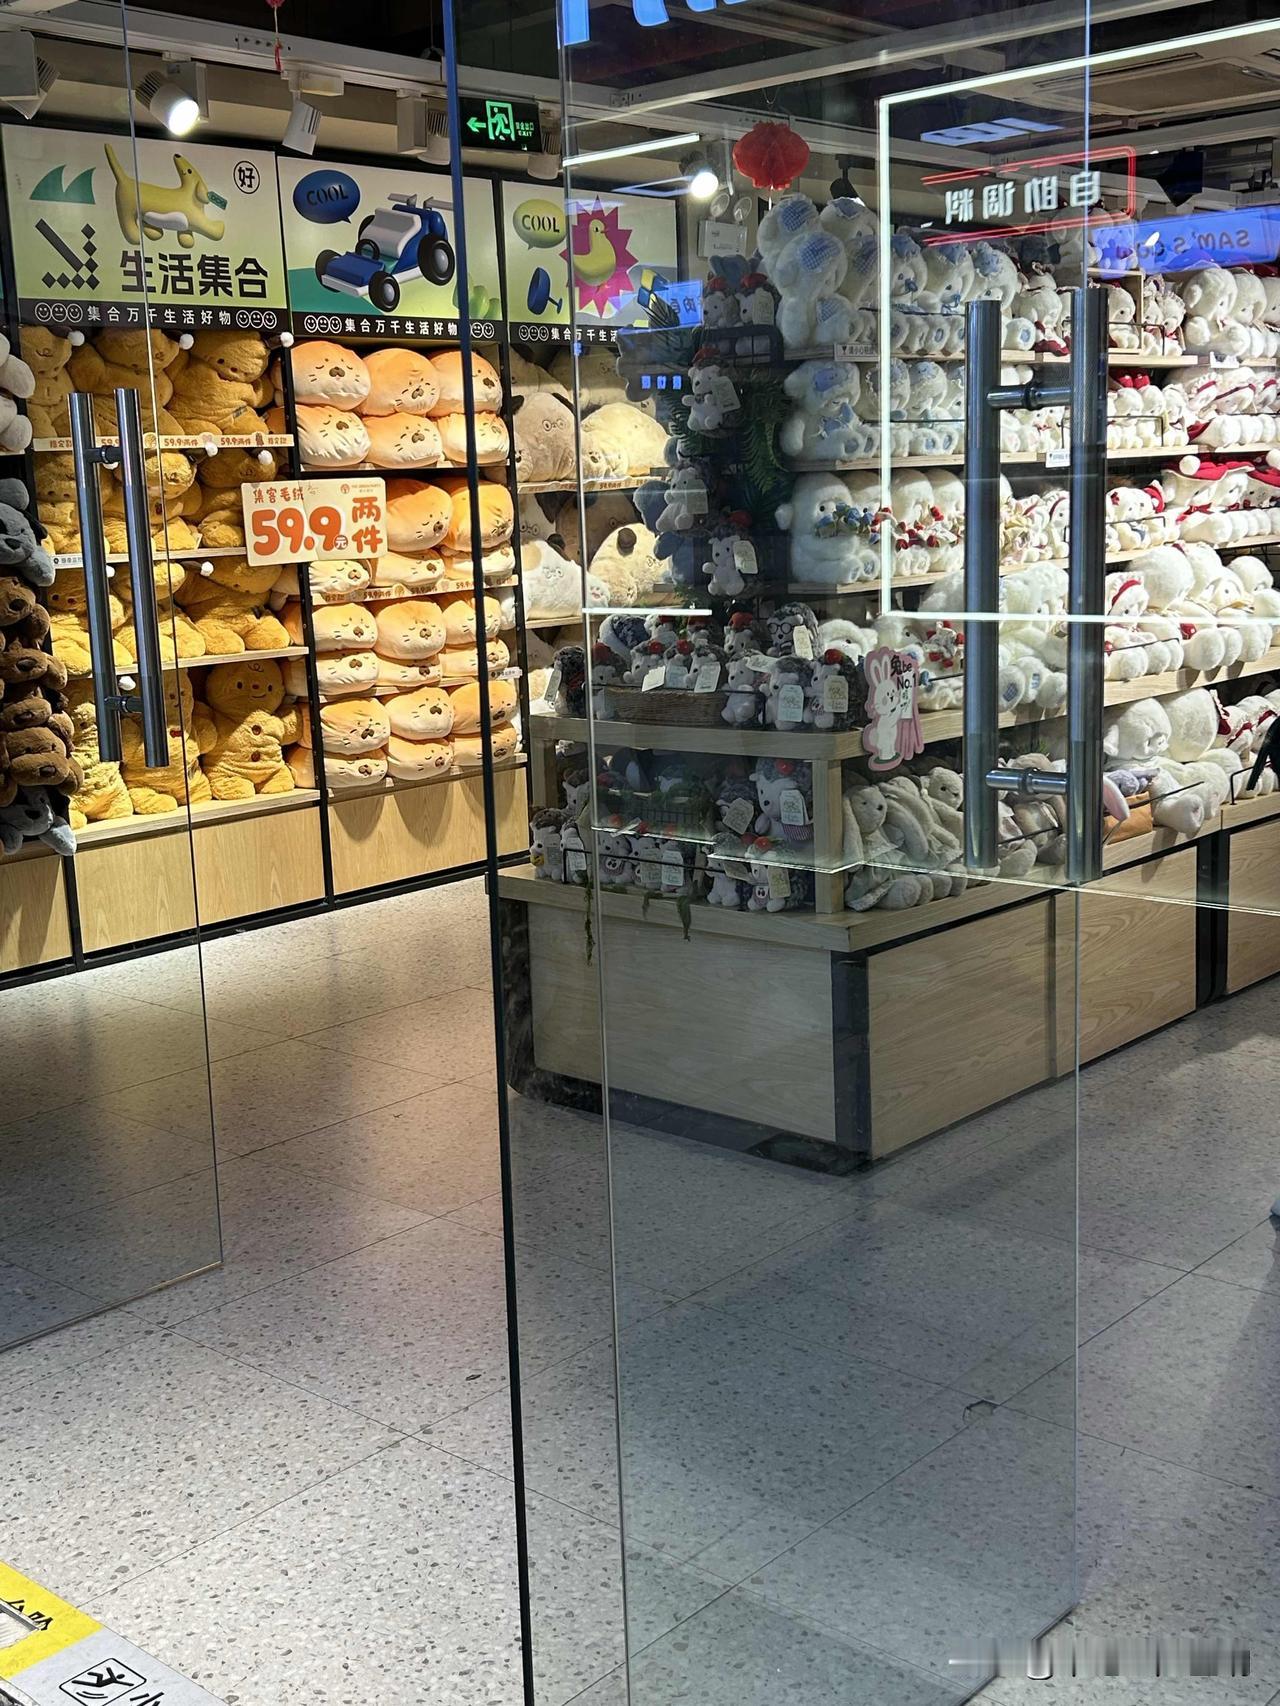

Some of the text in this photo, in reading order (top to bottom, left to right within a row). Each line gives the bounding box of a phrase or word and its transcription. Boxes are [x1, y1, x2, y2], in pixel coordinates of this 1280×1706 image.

[306, 183, 349, 207] COOL
[521, 214, 560, 234] COOL
[120, 250, 269, 299] 生活集合
[87, 306, 232, 326] 集合万千生活好物
[345, 318, 458, 336] 集合万千生活好物
[351, 496, 384, 553] 两件
